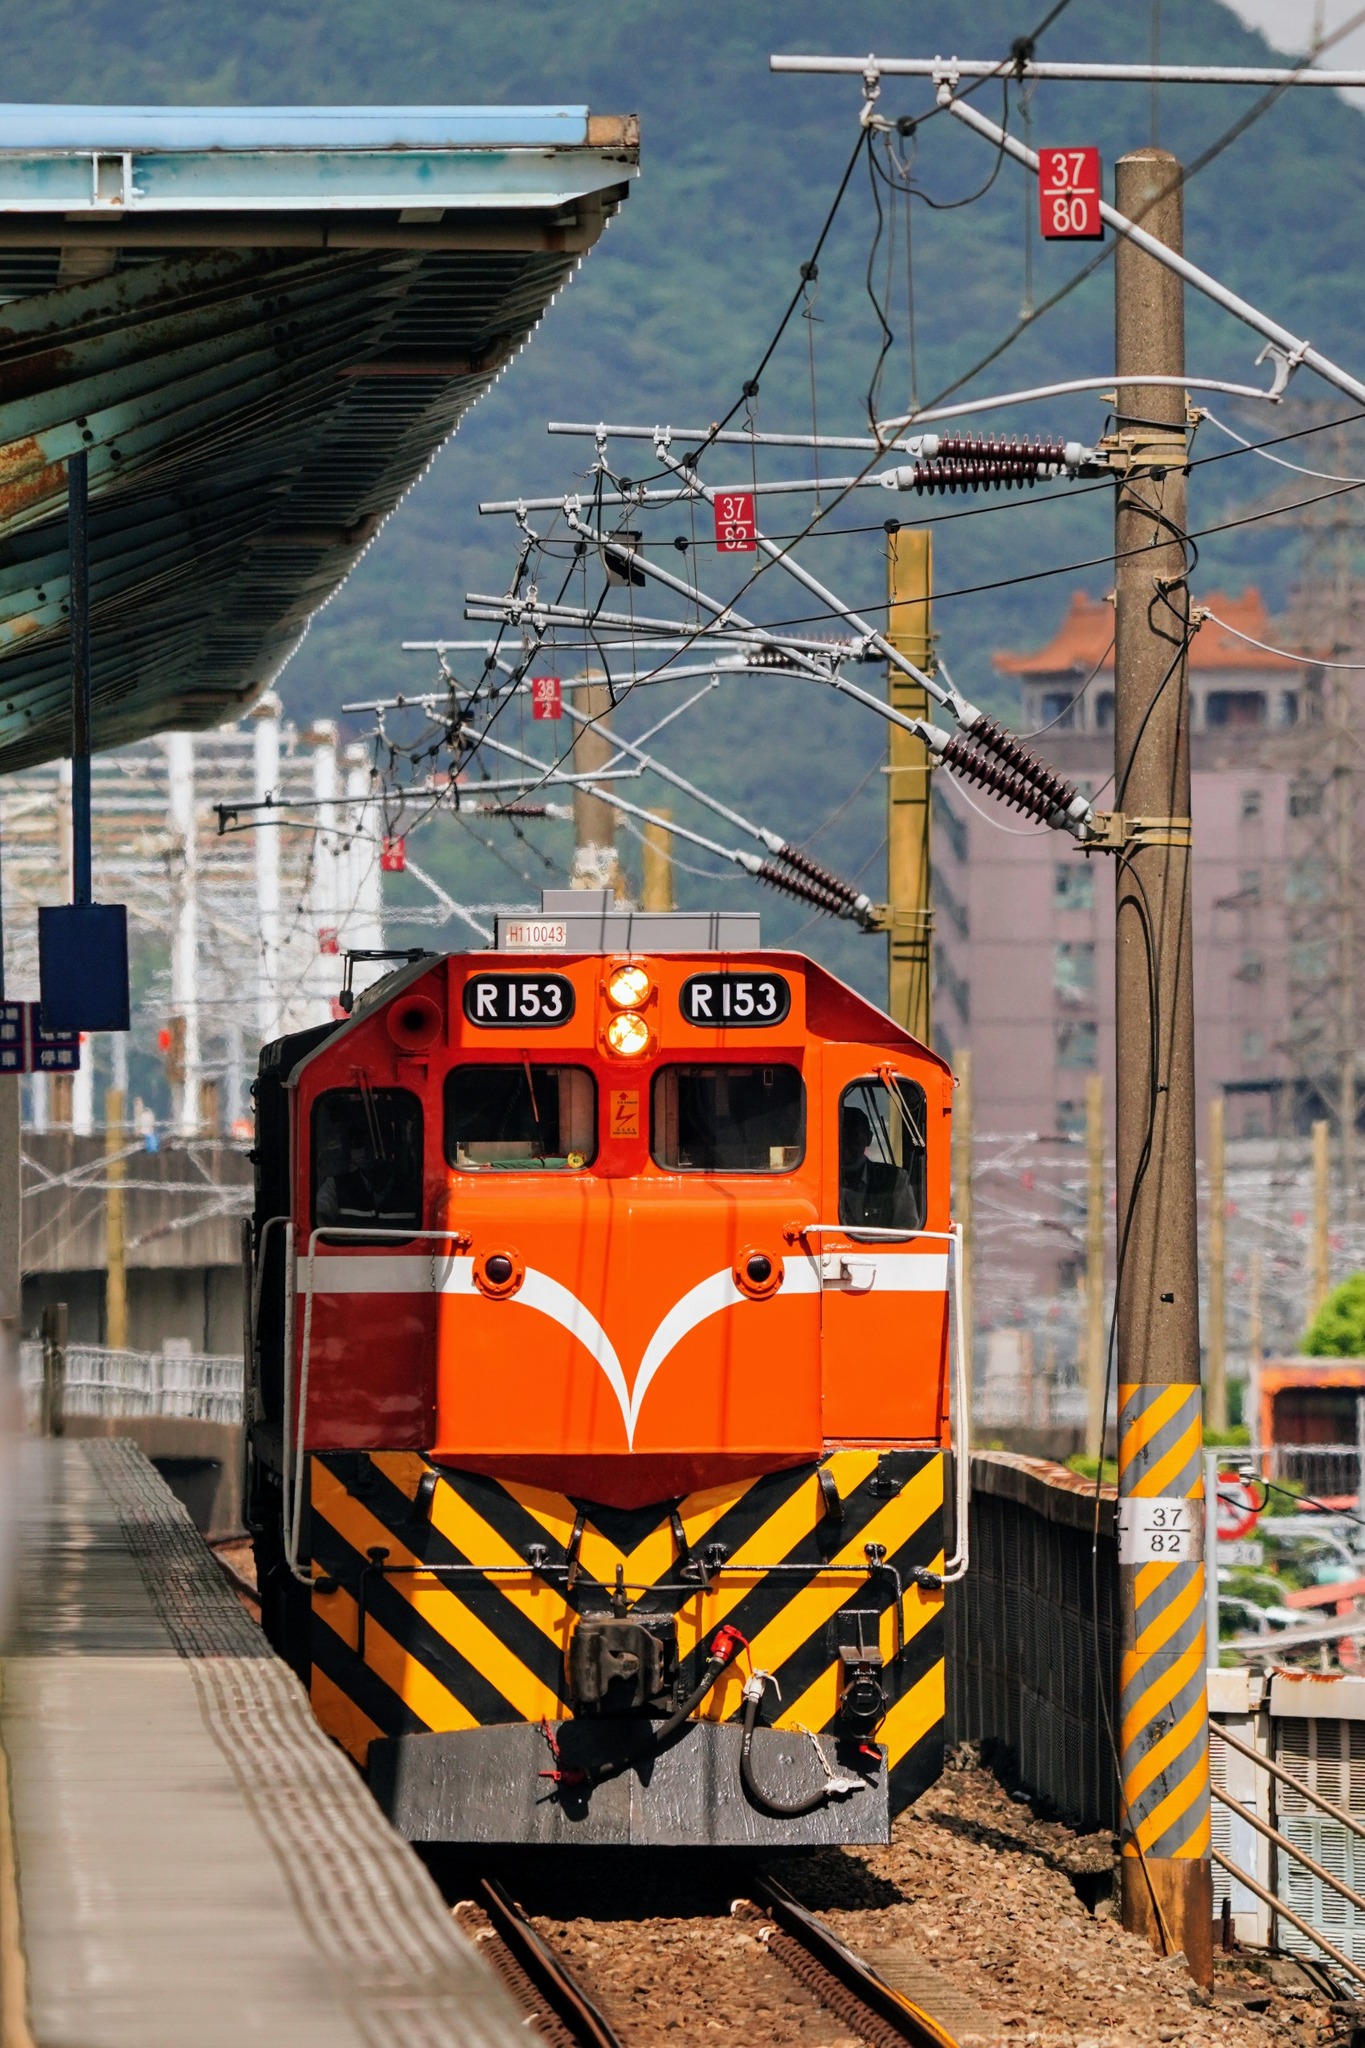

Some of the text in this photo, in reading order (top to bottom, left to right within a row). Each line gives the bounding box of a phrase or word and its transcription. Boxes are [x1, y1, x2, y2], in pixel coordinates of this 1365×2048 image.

[1051, 152, 1085, 187] 37
[1053, 198, 1087, 232] 80
[723, 497, 745, 519] 37
[725, 527, 747, 549] 82
[537, 680, 555, 697] 38
[509, 926, 563, 942] H110043
[1153, 1508, 1183, 1527] 37
[1151, 1534, 1181, 1552] 82
